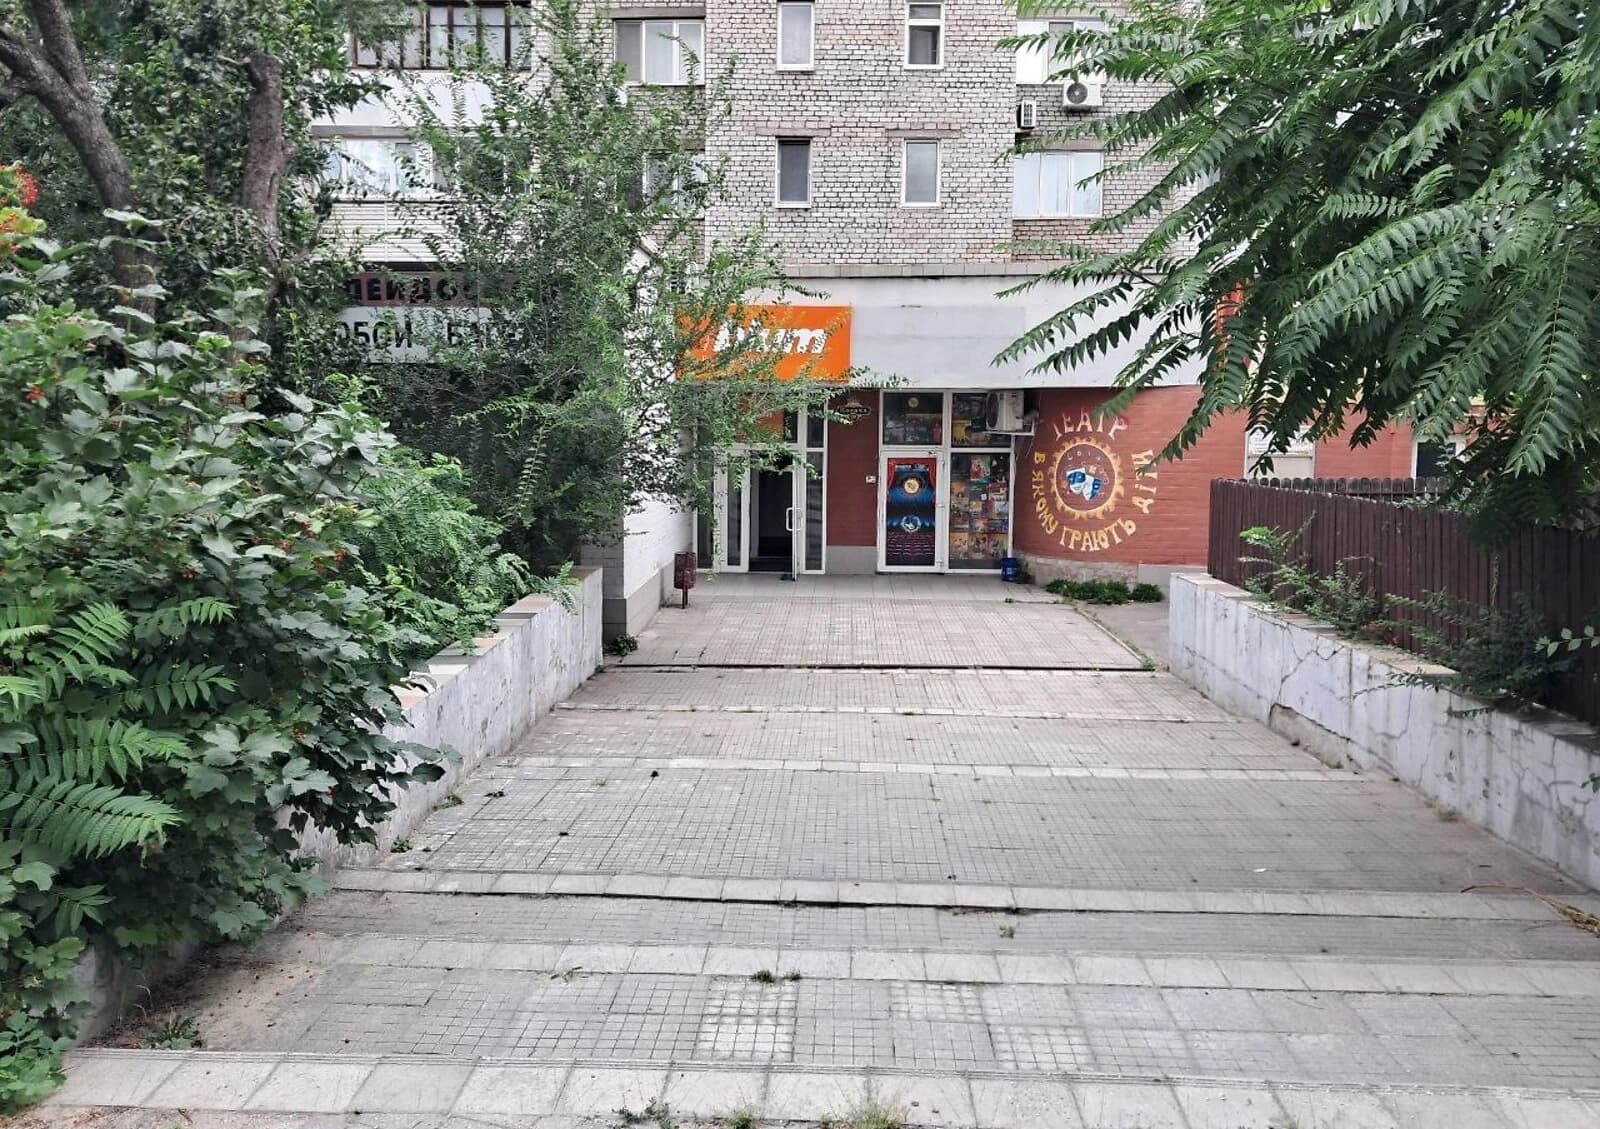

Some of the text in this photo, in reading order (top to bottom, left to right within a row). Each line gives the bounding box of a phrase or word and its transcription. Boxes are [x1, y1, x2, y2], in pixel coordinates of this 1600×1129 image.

[1033, 451, 1046, 465] В
[1032, 471, 1059, 536] ЯКОМУ
[1059, 518, 1137, 552] ГРАЮТЬ
